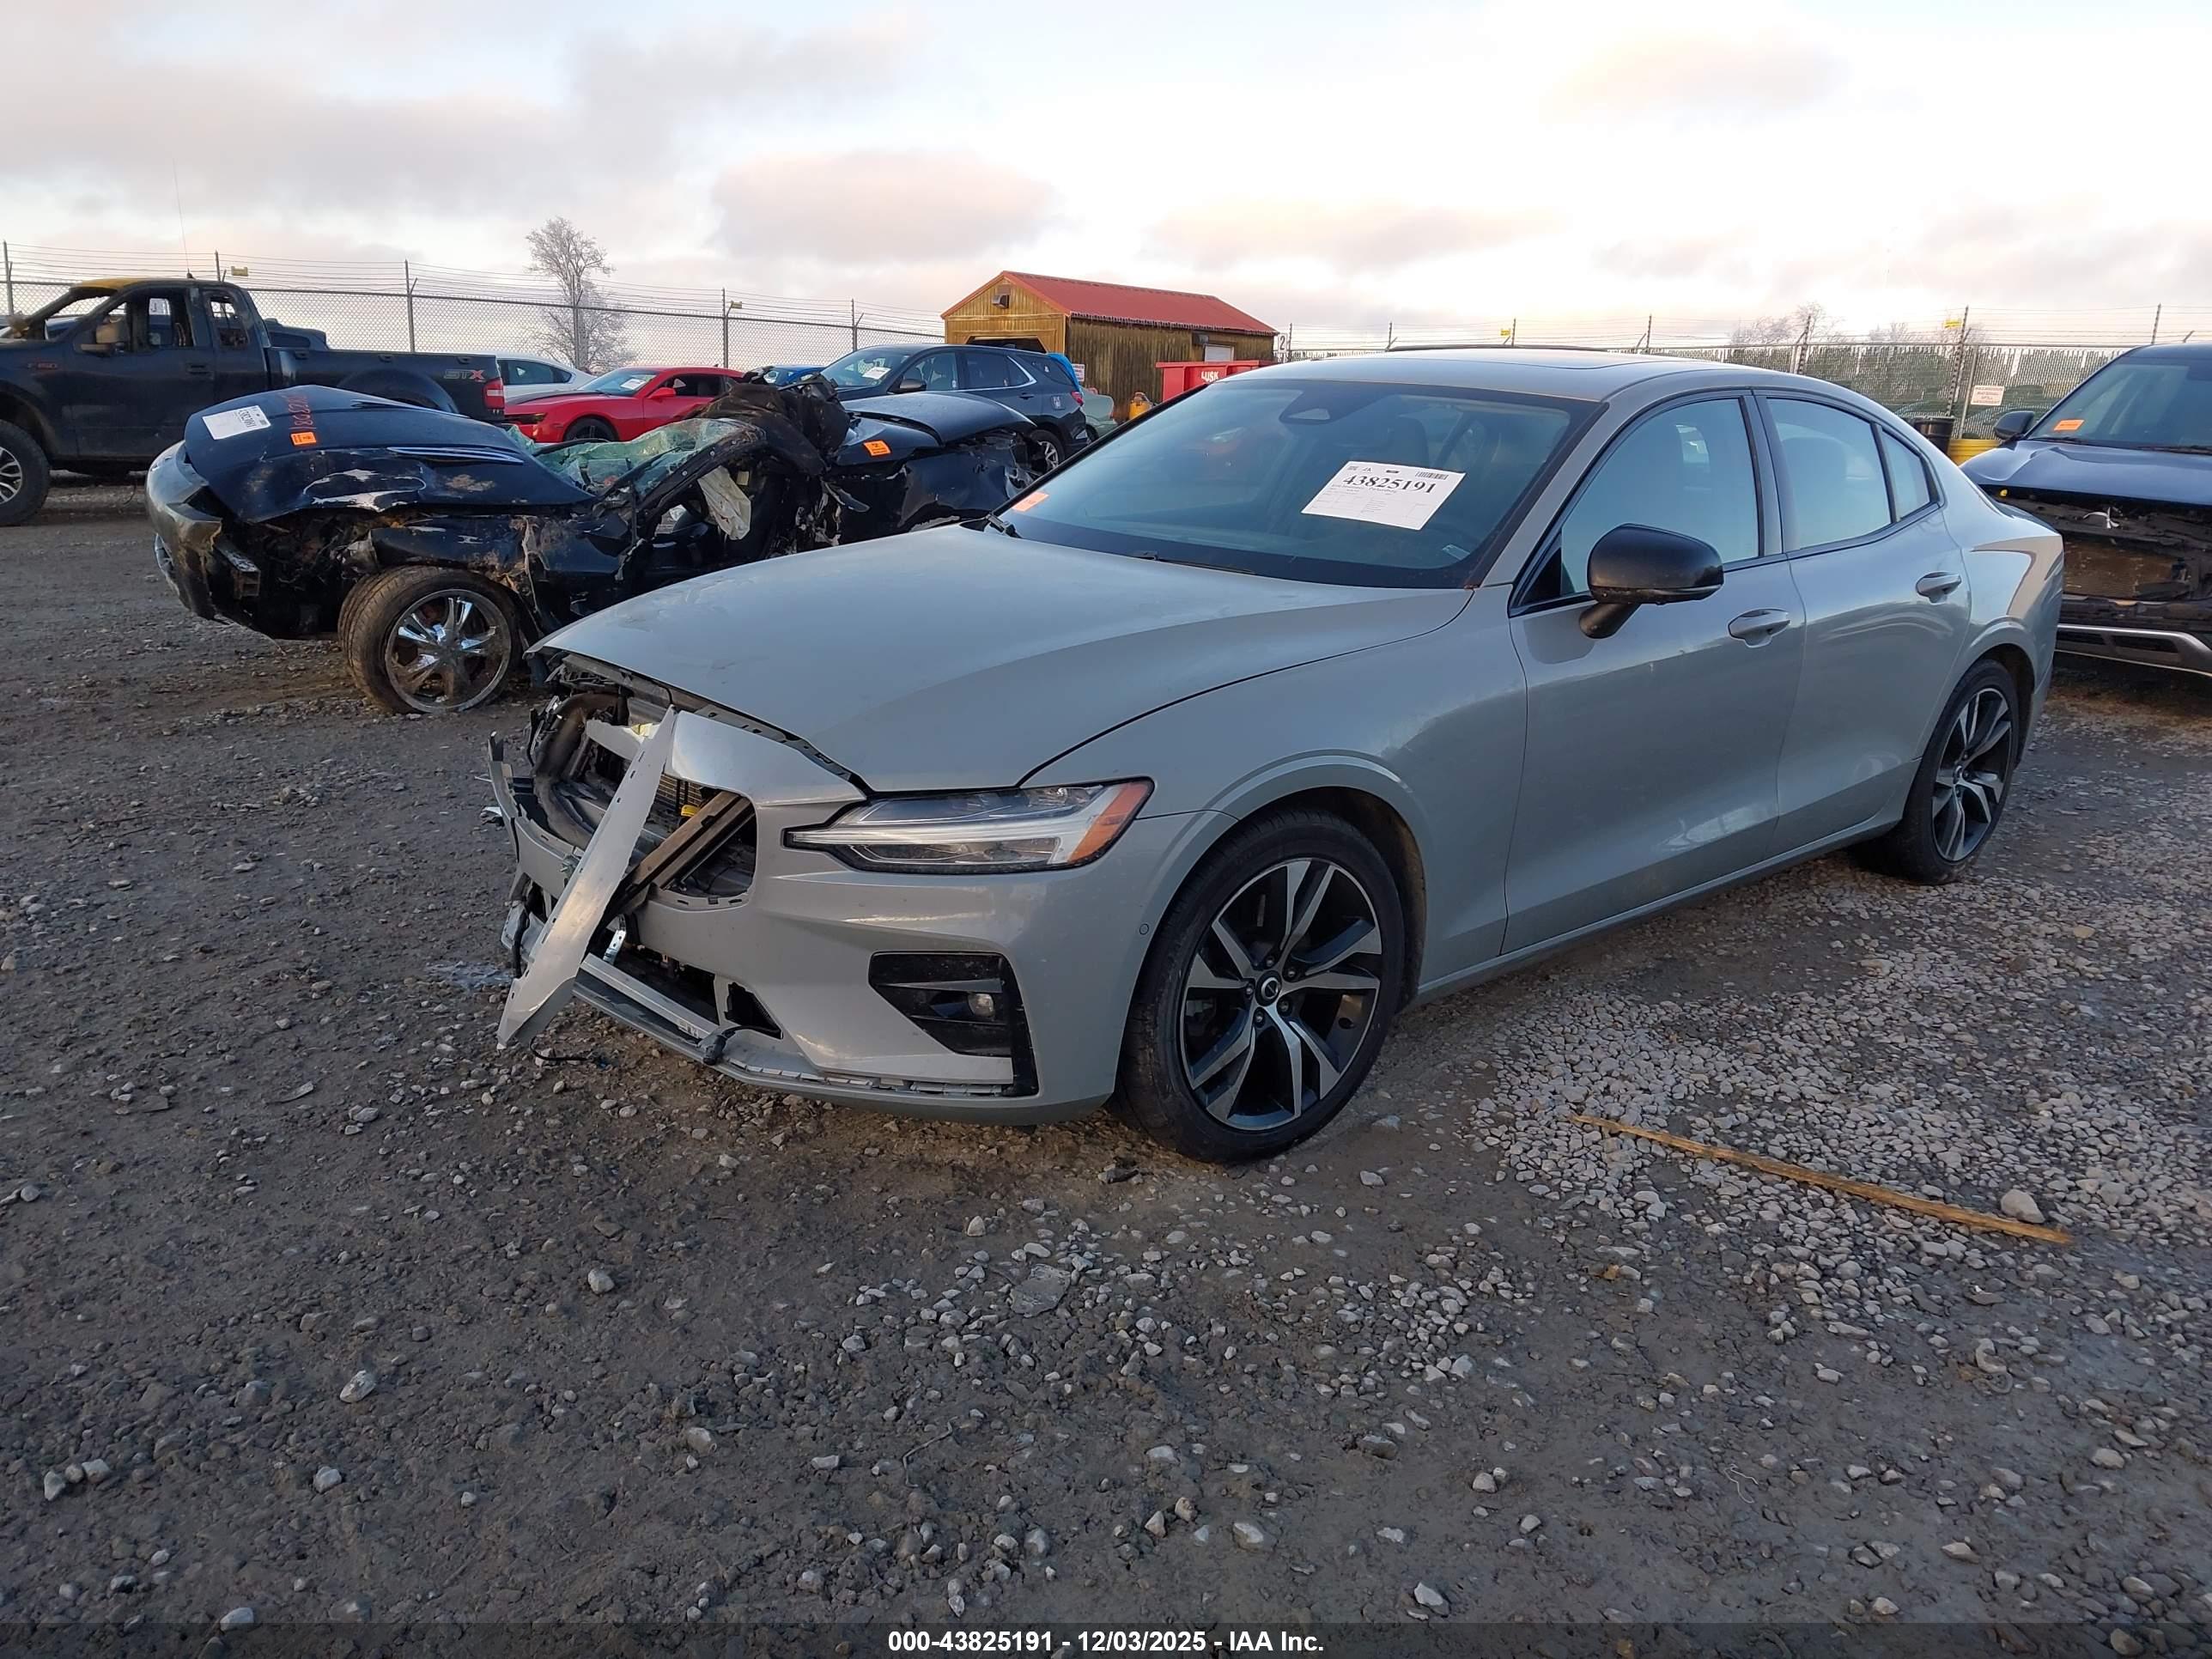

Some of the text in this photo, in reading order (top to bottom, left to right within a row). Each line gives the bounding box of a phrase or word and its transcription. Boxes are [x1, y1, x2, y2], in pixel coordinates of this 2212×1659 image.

[1279, 335, 1286, 351] 2
[443, 368, 485, 380] STX
[1200, 370, 1219, 383] LUSK
[1342, 473, 1437, 494] 43825191
